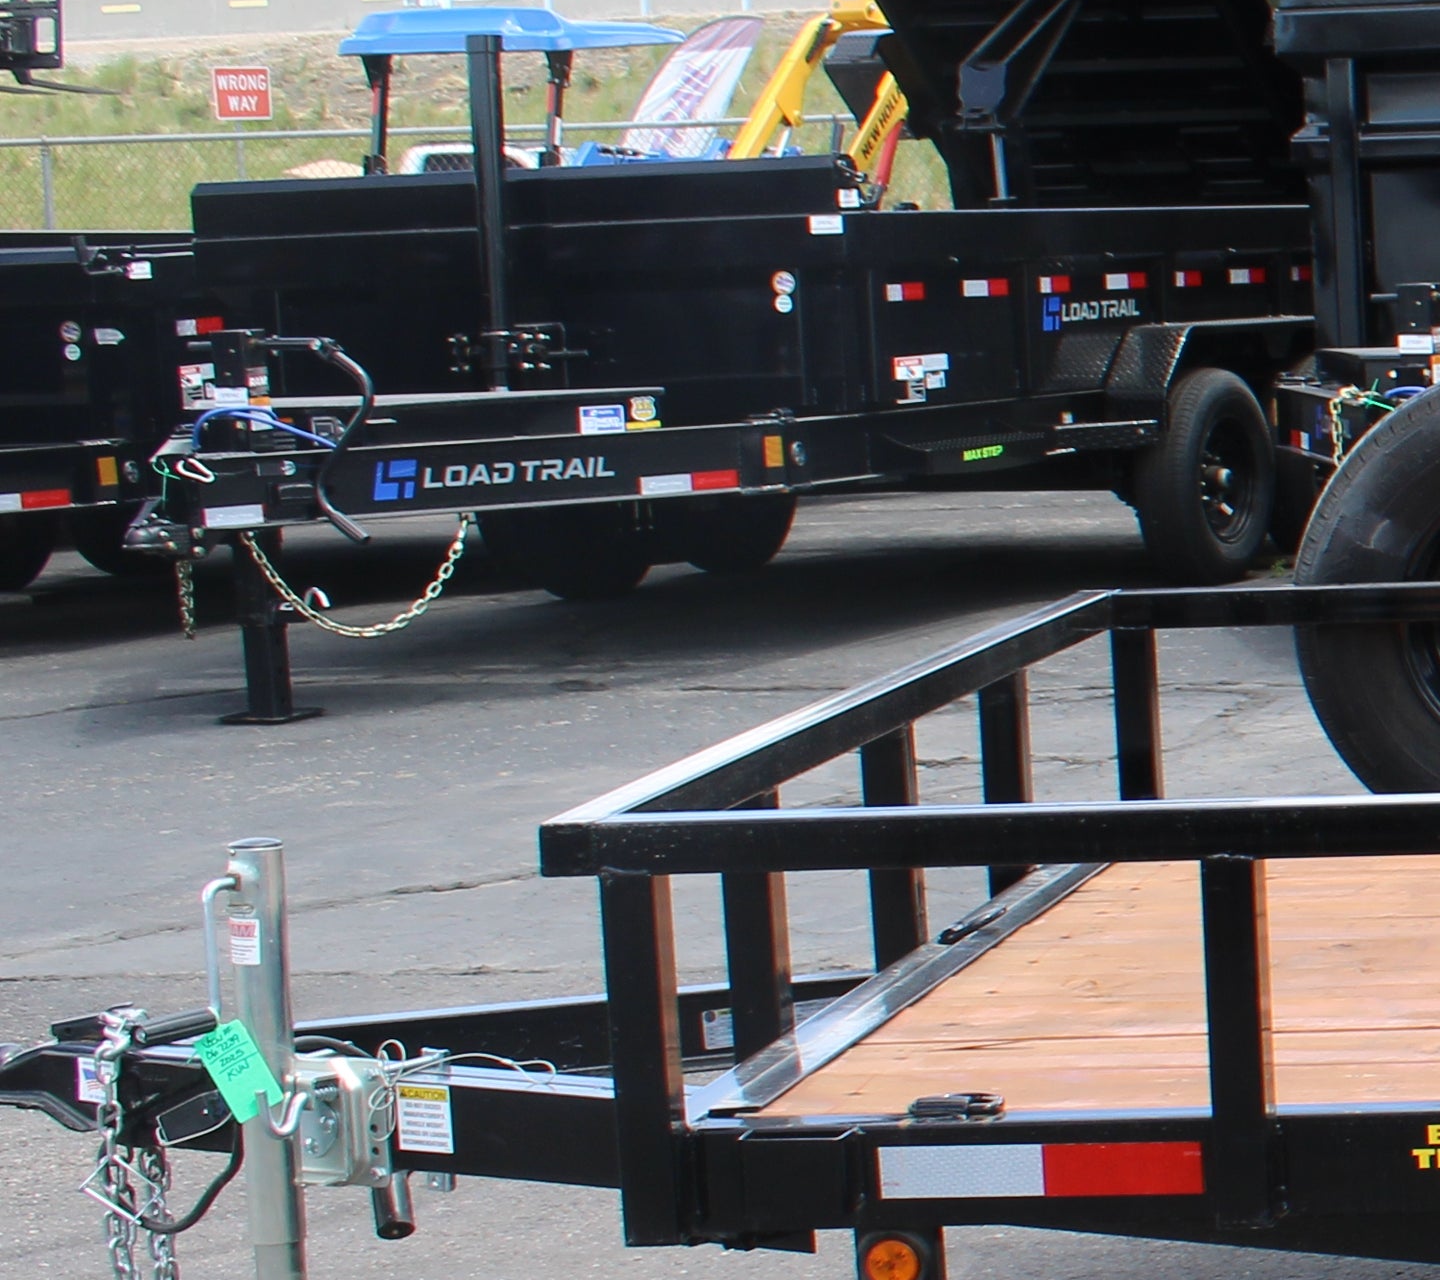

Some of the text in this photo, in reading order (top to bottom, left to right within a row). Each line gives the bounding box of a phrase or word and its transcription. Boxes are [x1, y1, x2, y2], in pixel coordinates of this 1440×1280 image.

[216, 74, 267, 91] WRONG
[227, 95, 259, 112] WAY
[861, 89, 902, 160] NEW HOLL
[1061, 298, 1140, 322] LOAD TRAIL
[422, 456, 615, 489] LOAD TRAIL
[407, 1089, 447, 1100] CAUTION
